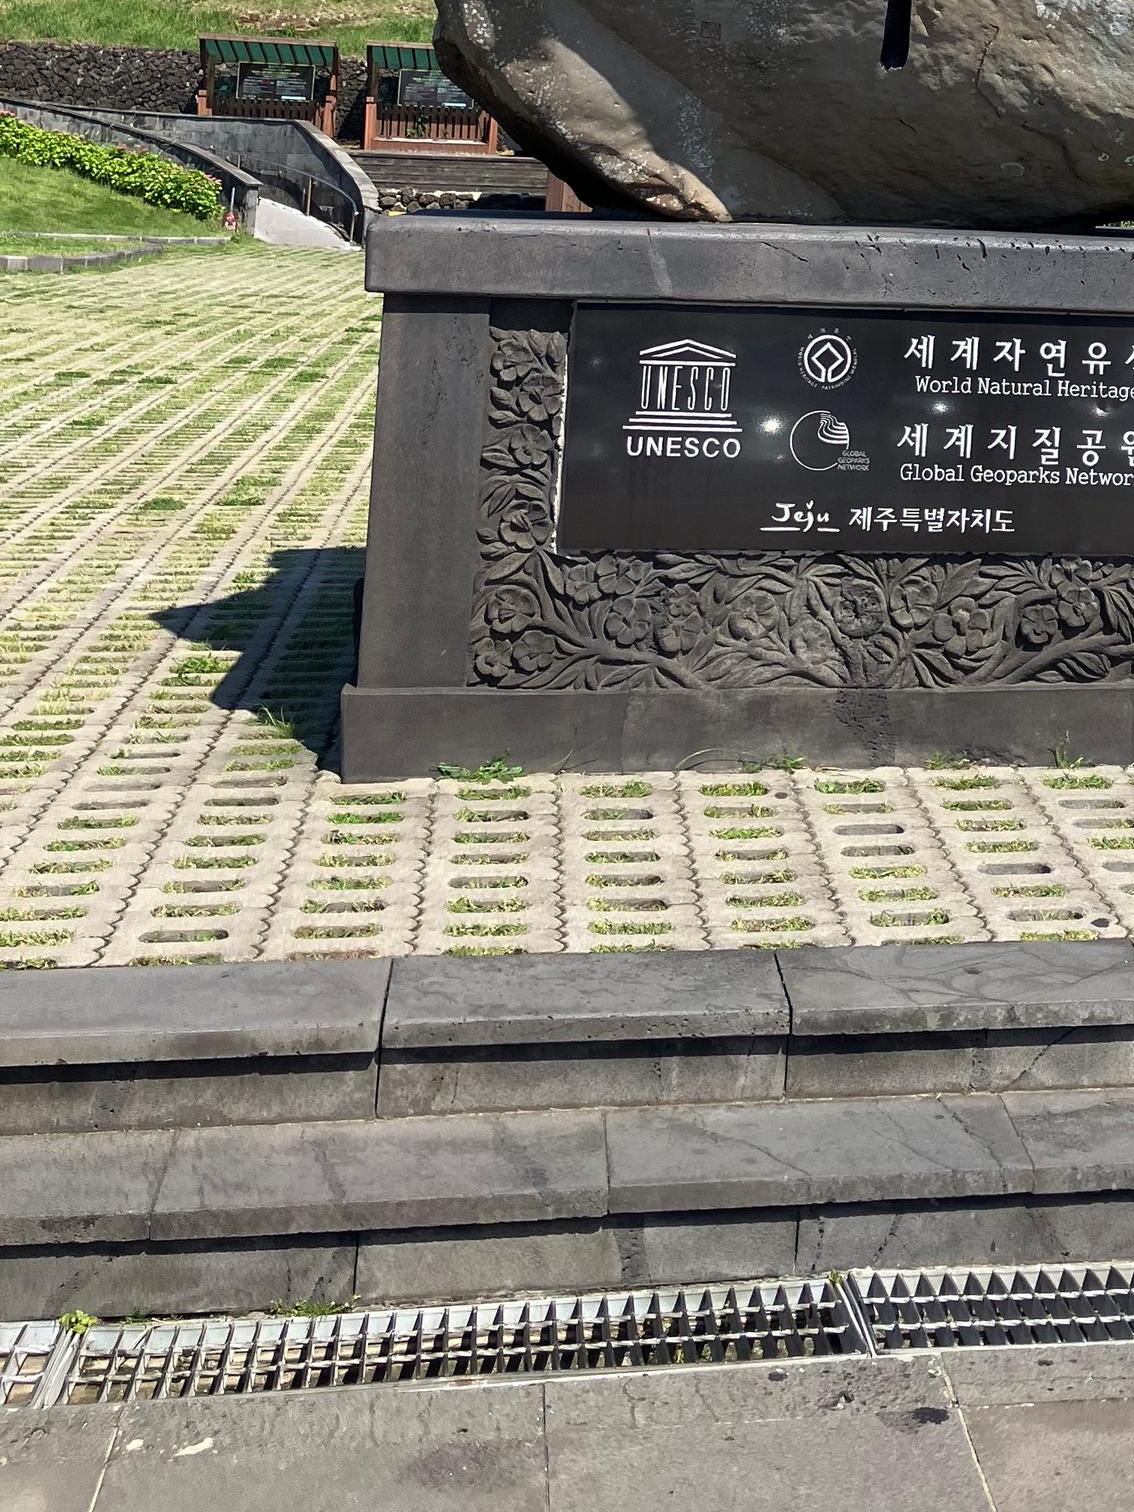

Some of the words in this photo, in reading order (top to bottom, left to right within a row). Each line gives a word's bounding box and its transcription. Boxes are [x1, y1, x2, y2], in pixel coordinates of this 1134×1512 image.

[641, 365, 731, 411] UNESCO
[915, 374, 972, 395] World
[977, 377, 1052, 397] Natural
[626, 435, 741, 458] UNESCO
[900, 463, 965, 483] Global
[970, 465, 1061, 486] Geoparks
[771, 499, 830, 533] Jeju
[849, 506, 1015, 534] 제주특별자치도
